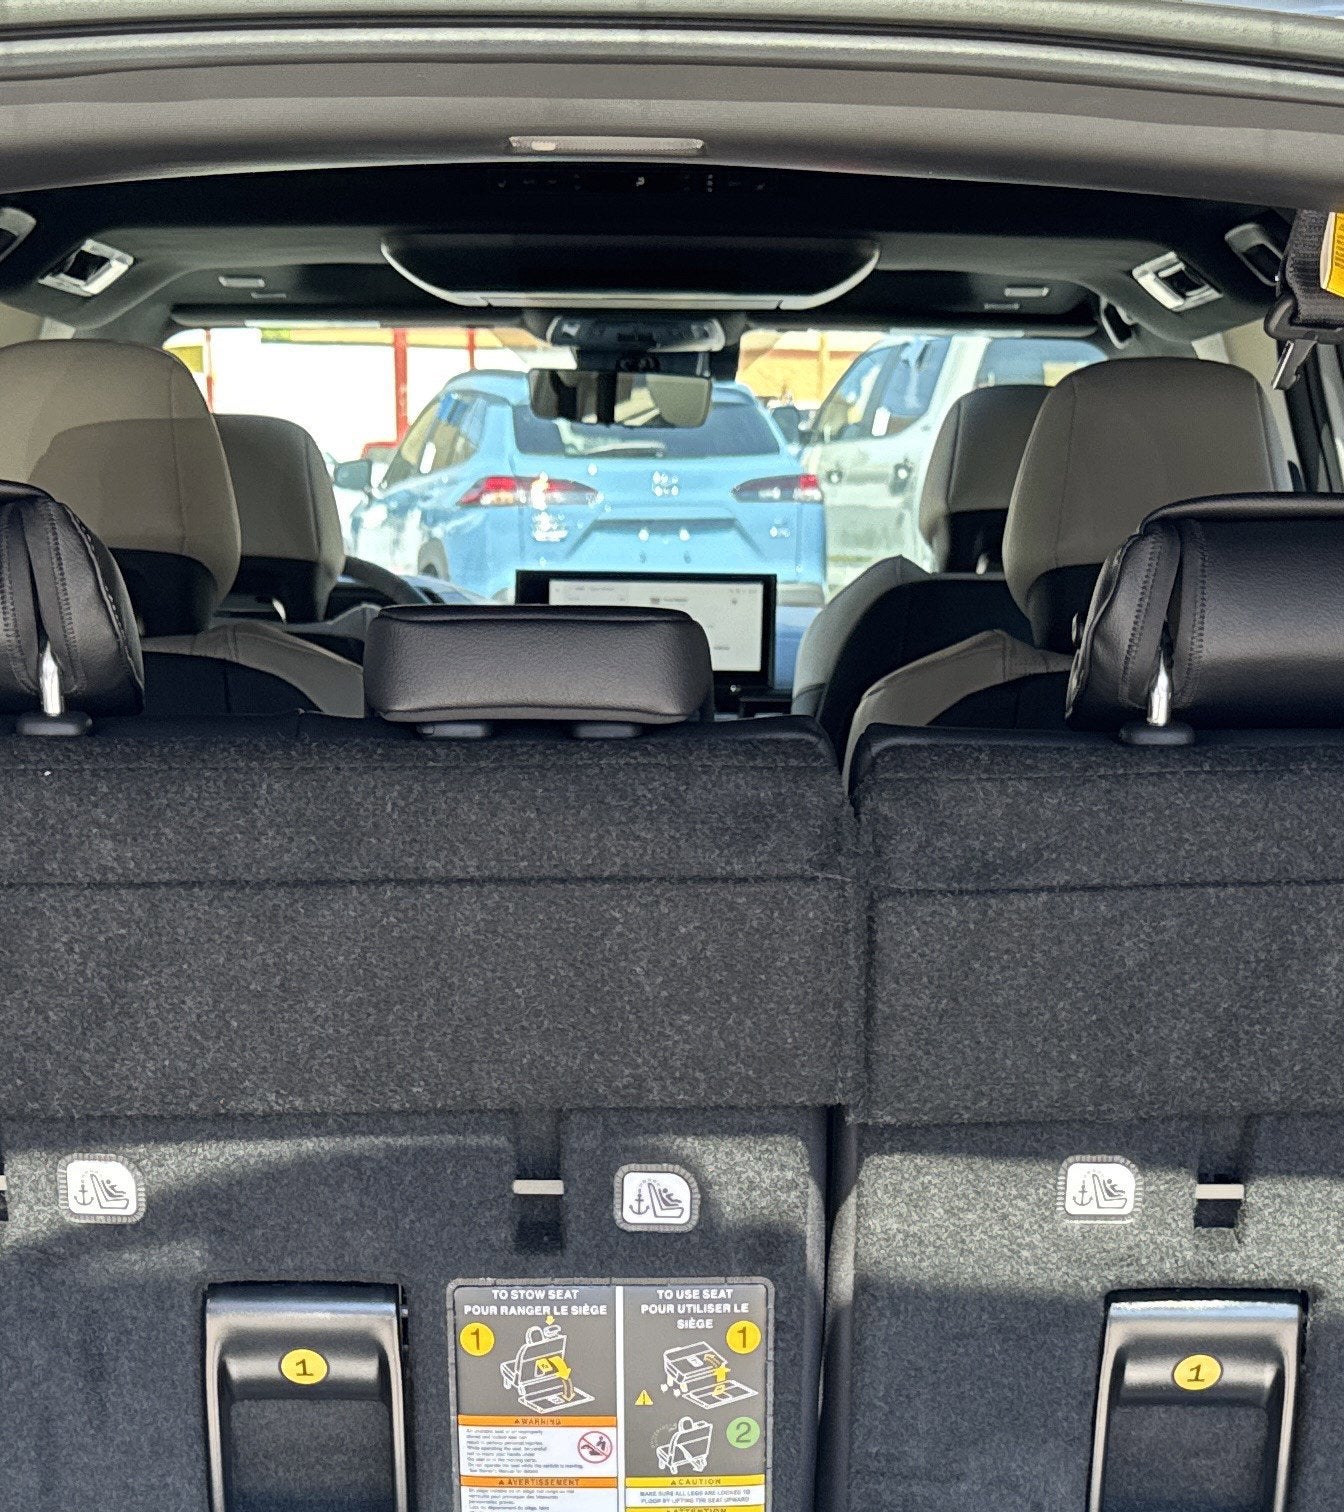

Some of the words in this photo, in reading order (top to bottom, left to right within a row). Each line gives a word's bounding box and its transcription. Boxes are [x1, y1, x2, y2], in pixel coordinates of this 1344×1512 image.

[492, 1289, 508, 1300] TO
[510, 1289, 545, 1300] STOW
[547, 1289, 579, 1300] SEAT
[657, 1289, 673, 1300] TO
[676, 1289, 700, 1300] USE
[702, 1289, 733, 1300] SEAT
[463, 1305, 498, 1315] POUR
[500, 1305, 550, 1315] RANGER
[553, 1305, 568, 1315] LE
[571, 1303, 607, 1315] SIÈGE
[641, 1304, 674, 1314] POUR
[677, 1304, 731, 1314] UTILISER
[734, 1303, 749, 1313] LE
[677, 1317, 714, 1329] SIÈGE
[470, 1328, 480, 1350] 1
[737, 1326, 746, 1349] 1
[296, 1358, 314, 1377] 1
[1187, 1364, 1205, 1383] 1
[736, 1422, 752, 1443] 2
[507, 1478, 580, 1486] AVERTISSEMENT
[678, 1478, 722, 1486] CAUTION
